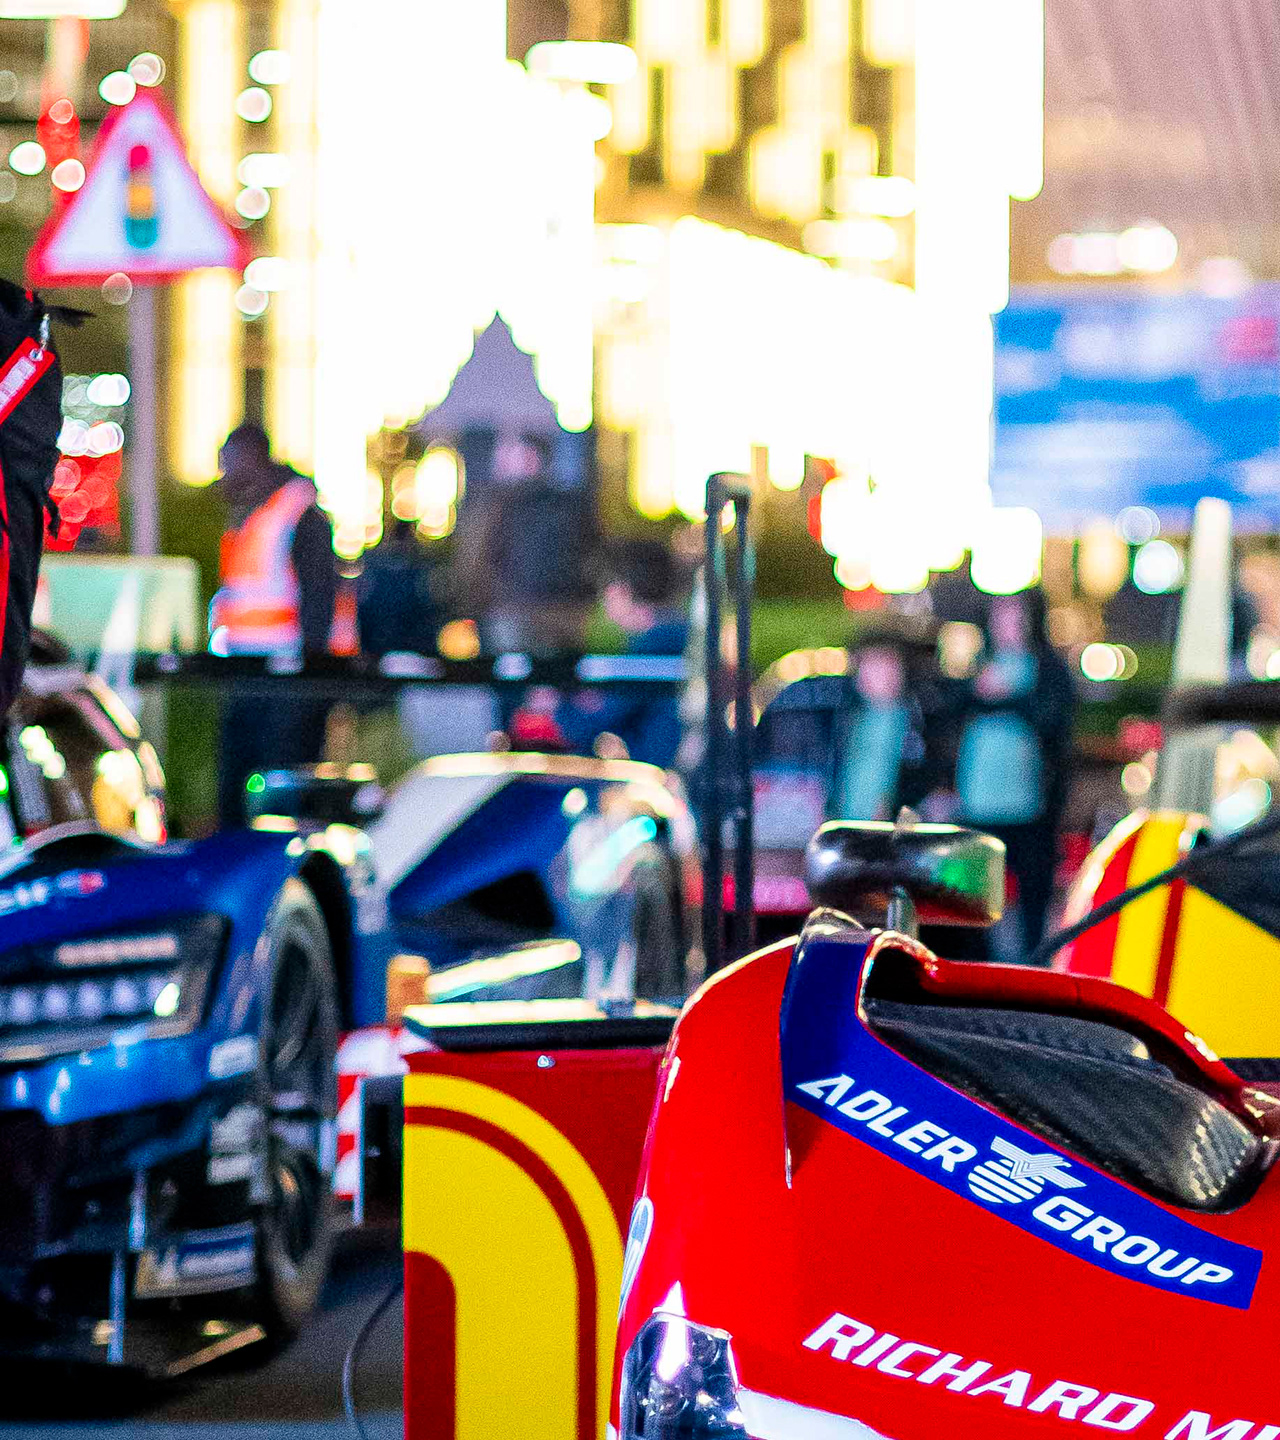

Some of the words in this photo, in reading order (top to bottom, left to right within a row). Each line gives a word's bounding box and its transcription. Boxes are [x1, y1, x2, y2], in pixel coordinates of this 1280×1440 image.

[796, 1073, 979, 1173] ADLER
[1031, 1194, 1234, 1285] GROUP
[802, 1312, 1155, 1431] RICHARD
